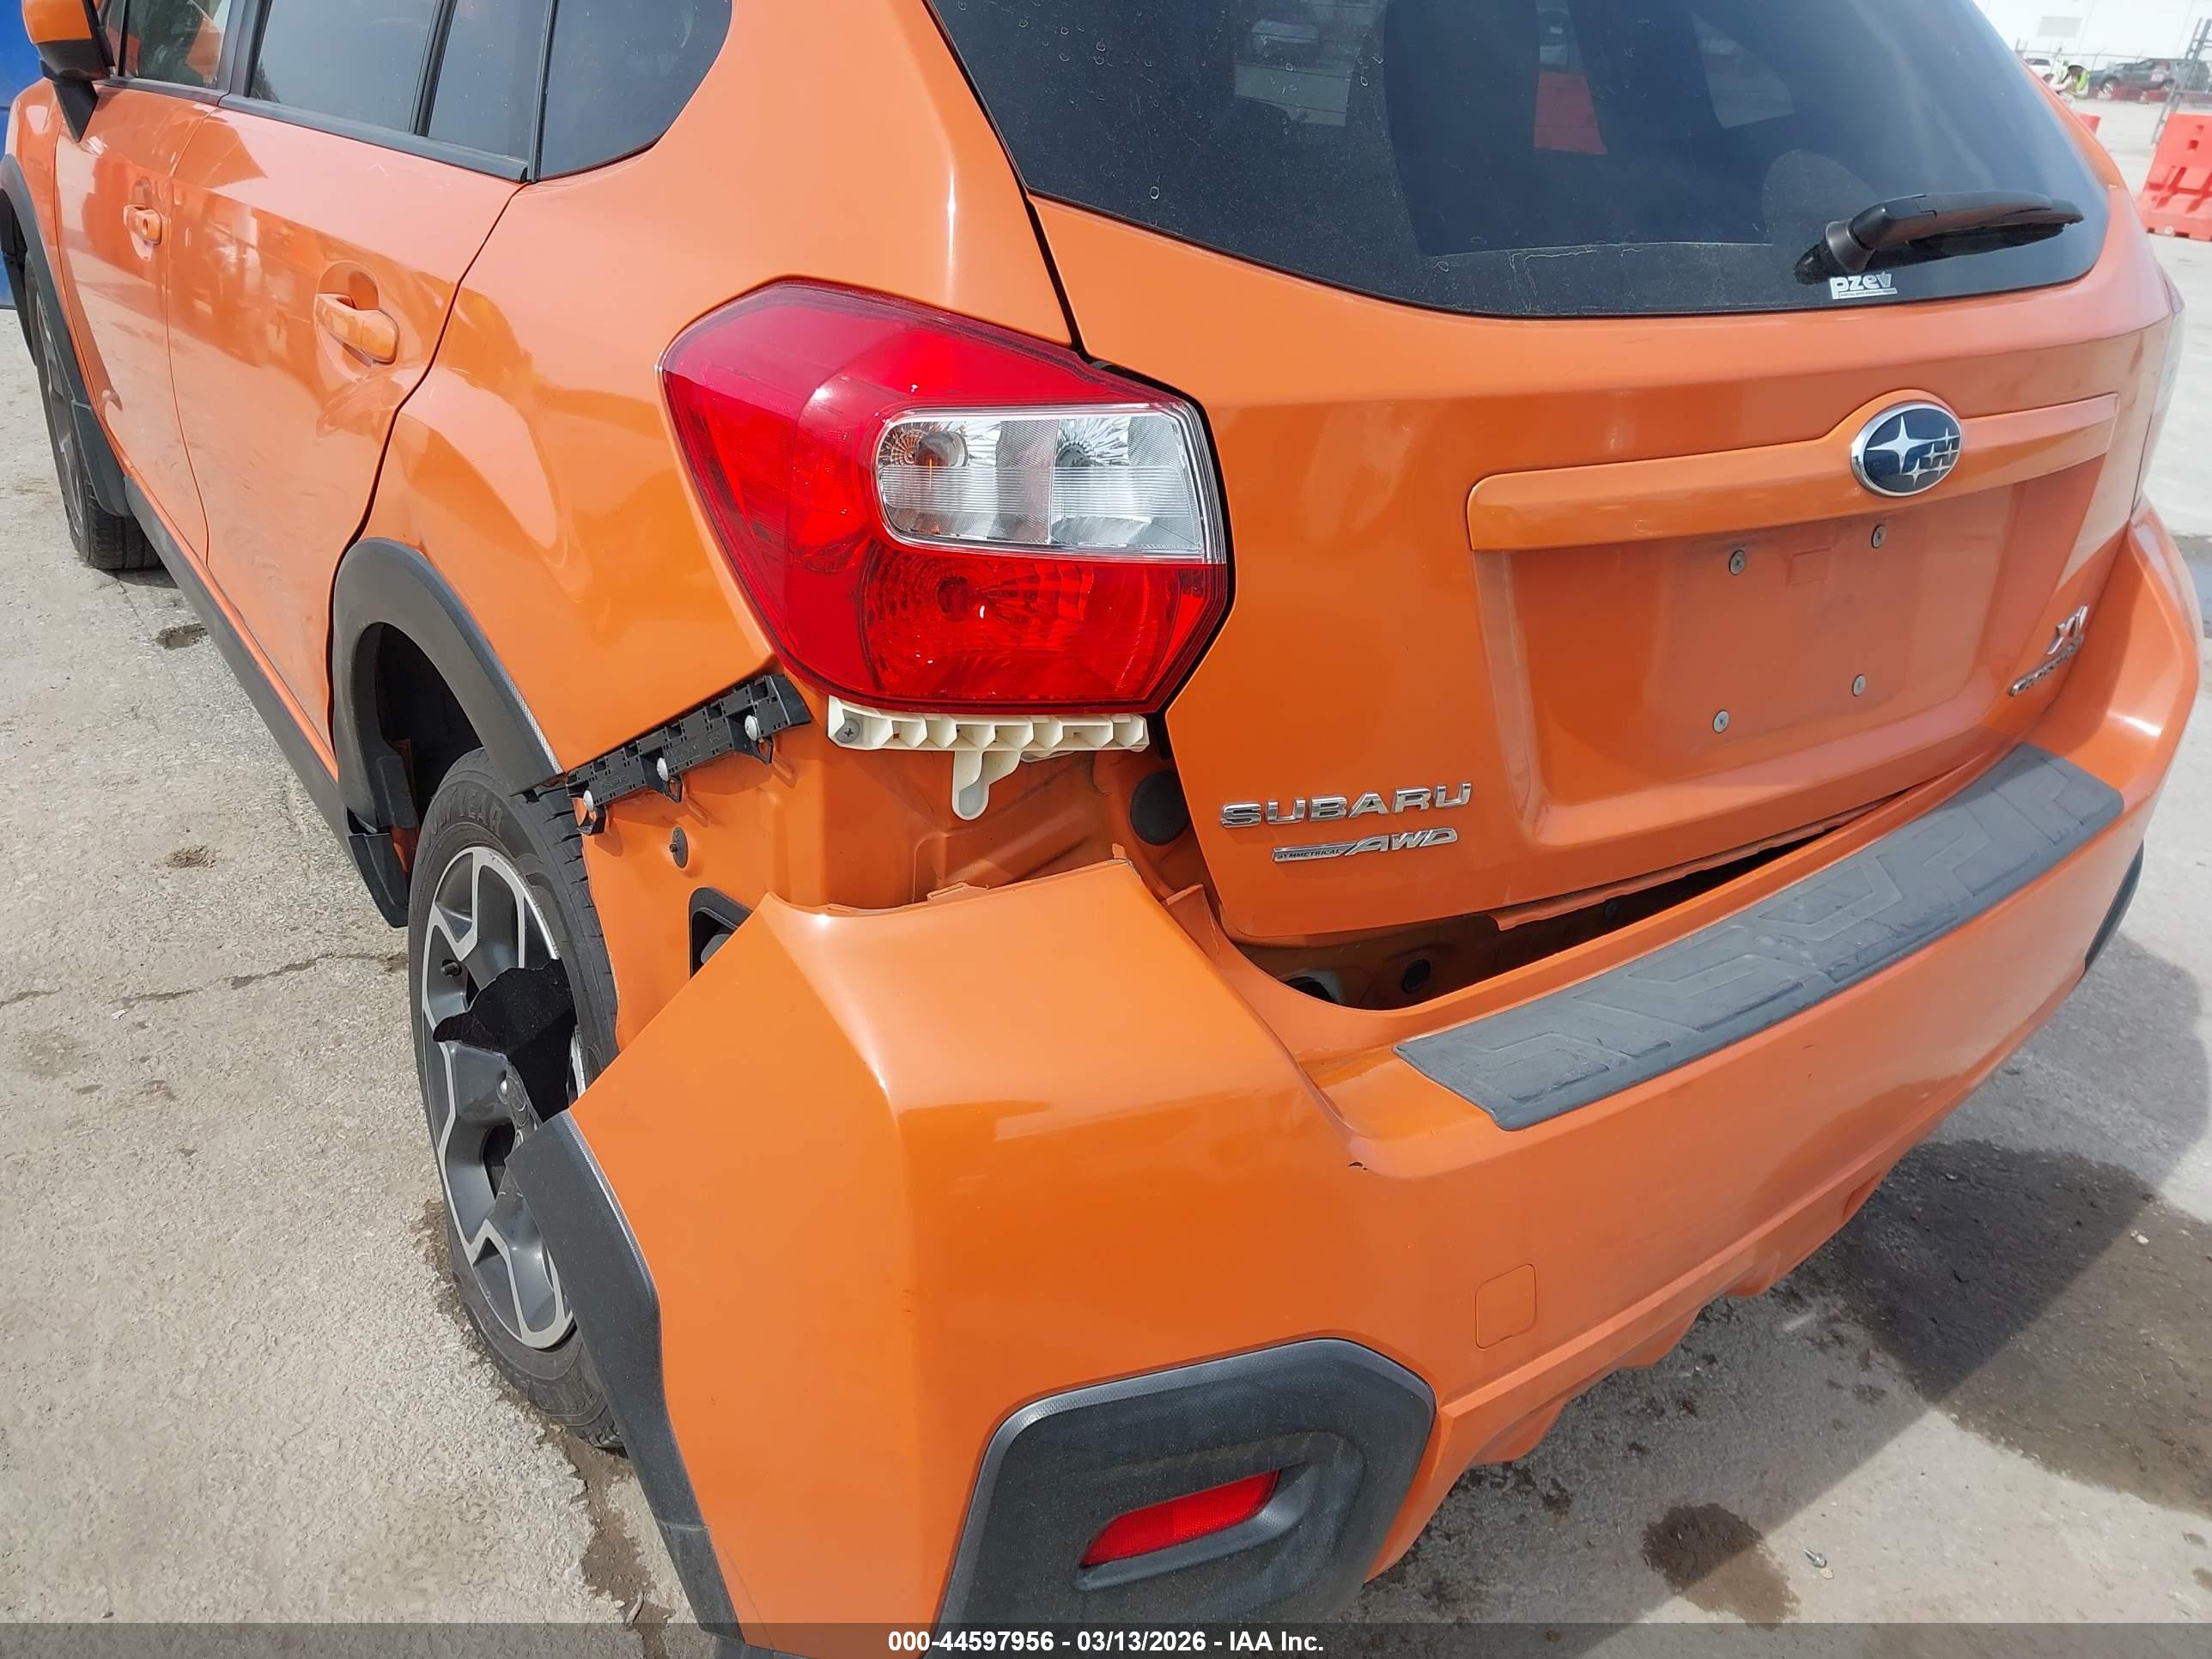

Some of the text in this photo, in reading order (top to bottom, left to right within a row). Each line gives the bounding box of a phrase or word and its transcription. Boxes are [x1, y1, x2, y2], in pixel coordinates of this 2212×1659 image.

[1220, 782, 1472, 829] SUBARU
[1277, 827, 1458, 860] SYMMETRICAL AWD
